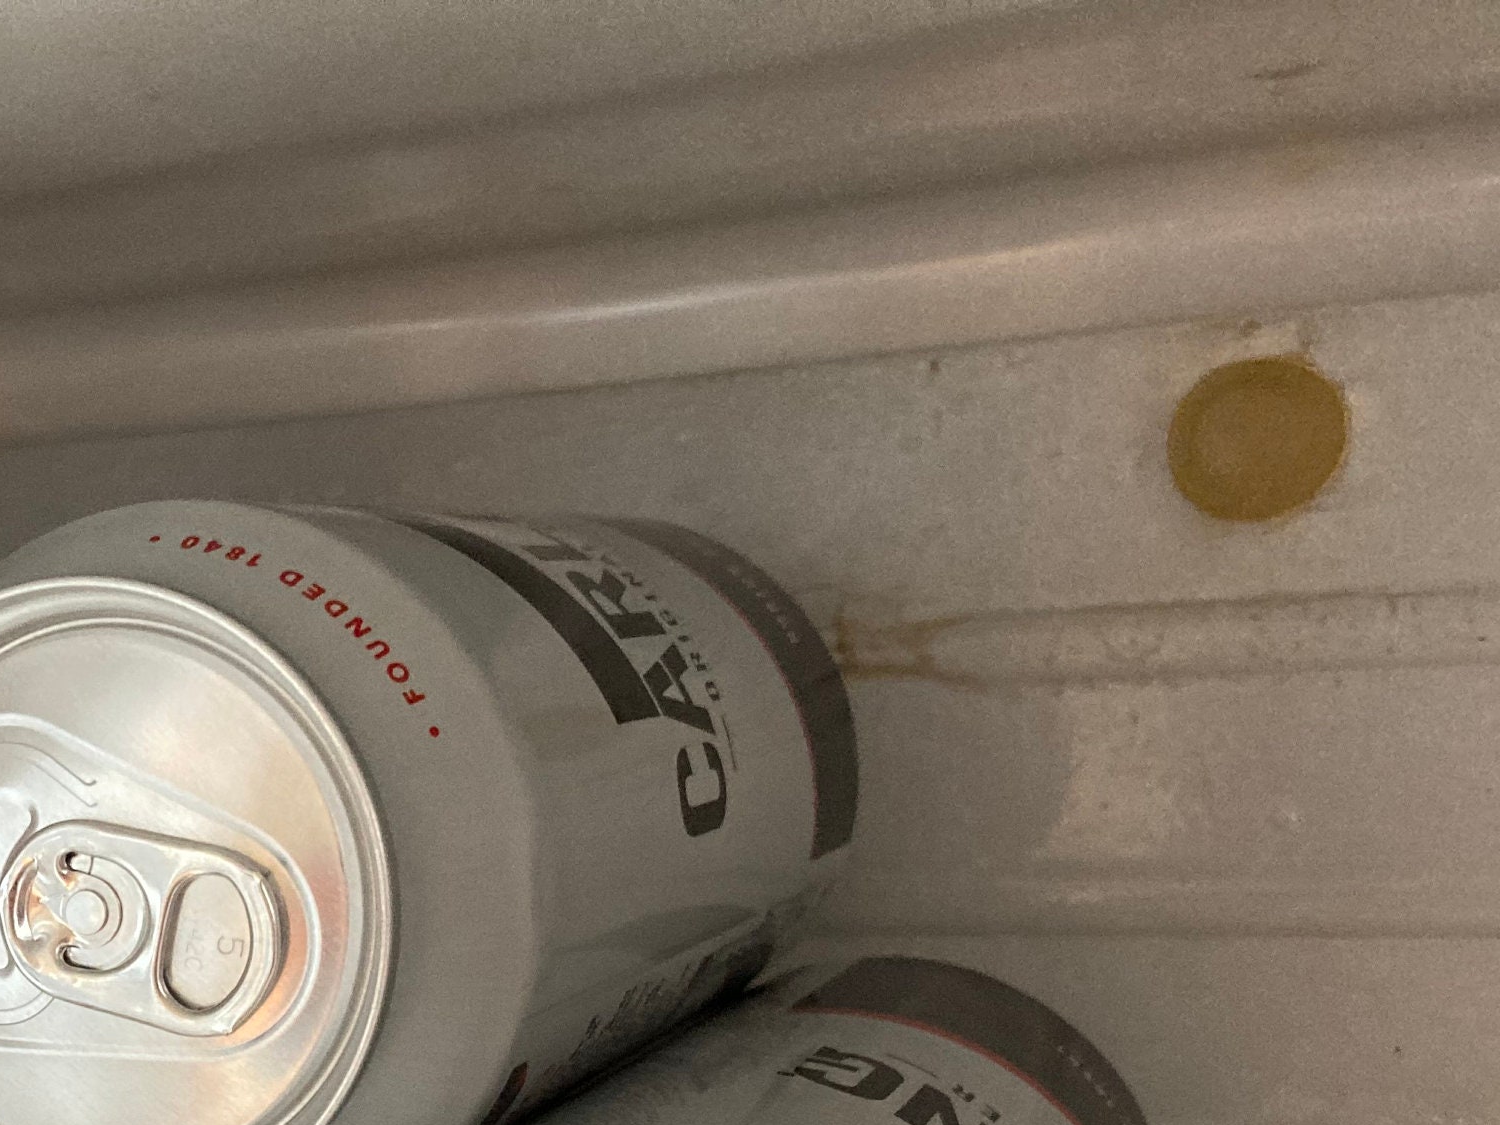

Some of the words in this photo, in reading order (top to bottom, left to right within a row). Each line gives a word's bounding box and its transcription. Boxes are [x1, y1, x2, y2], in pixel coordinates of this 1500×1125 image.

[181, 535, 262, 567] 1840
[279, 570, 426, 706] FOUNDED
[217, 935, 245, 958] 5
